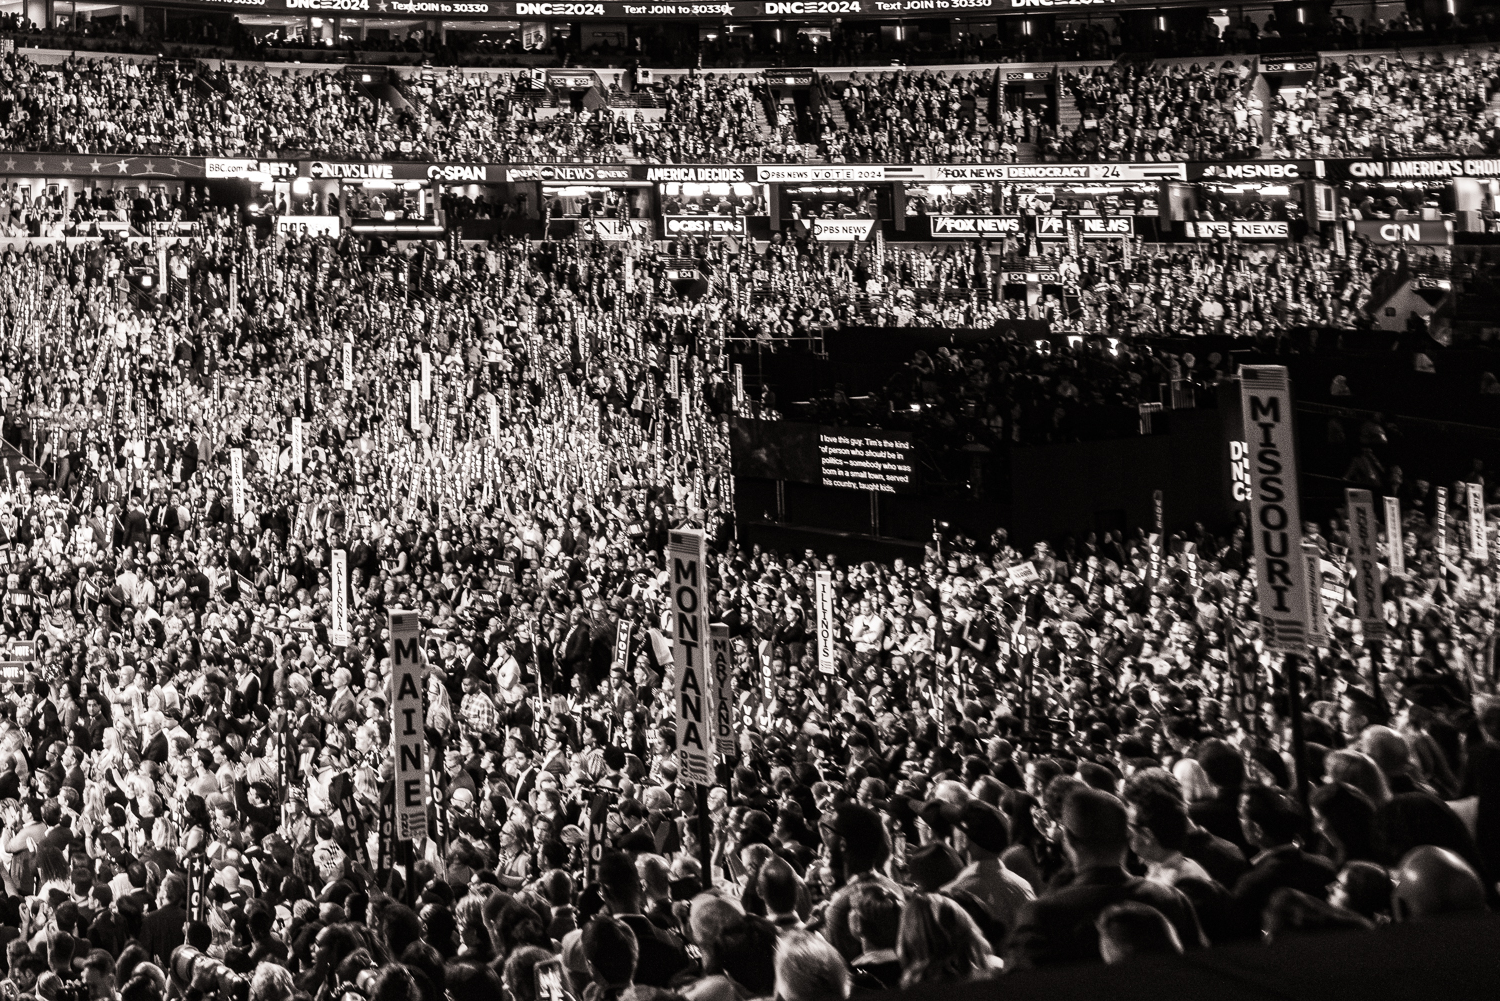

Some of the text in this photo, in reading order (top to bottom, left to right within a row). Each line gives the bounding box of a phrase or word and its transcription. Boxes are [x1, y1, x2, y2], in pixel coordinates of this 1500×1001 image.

[209, 163, 243, 173] BBC.com
[360, 165, 393, 178] LIVE
[554, 168, 594, 180] NEWS
[647, 168, 744, 181] AMERICA DECIDES
[771, 170, 786, 179] PBS
[787, 170, 809, 179] NEWS
[858, 171, 882, 179] 2024
[945, 166, 1121, 179] FOX NEWS DEMOCRACY 24
[1226, 164, 1299, 178] MSNBC
[1350, 162, 1384, 176] CNN
[1391, 161, 1463, 177] AMERICA'S
[823, 225, 867, 234] PBS NEWS
[946, 219, 1020, 232] FOX NEWS
[1242, 223, 1288, 235] NEWS
[1251, 395, 1291, 613] MISSOURI
[336, 561, 344, 632] CALIFORNIA
[821, 583, 830, 658] ILLINOIS
[14, 645, 30, 657] VOTE
[674, 557, 703, 751] MONTANA
[761, 654, 773, 699] VOTE
[712, 639, 732, 738] MARYLAND
[393, 636, 424, 808] MAINE
[431, 769, 445, 838] VOTE
[341, 796, 366, 865] VOTE
